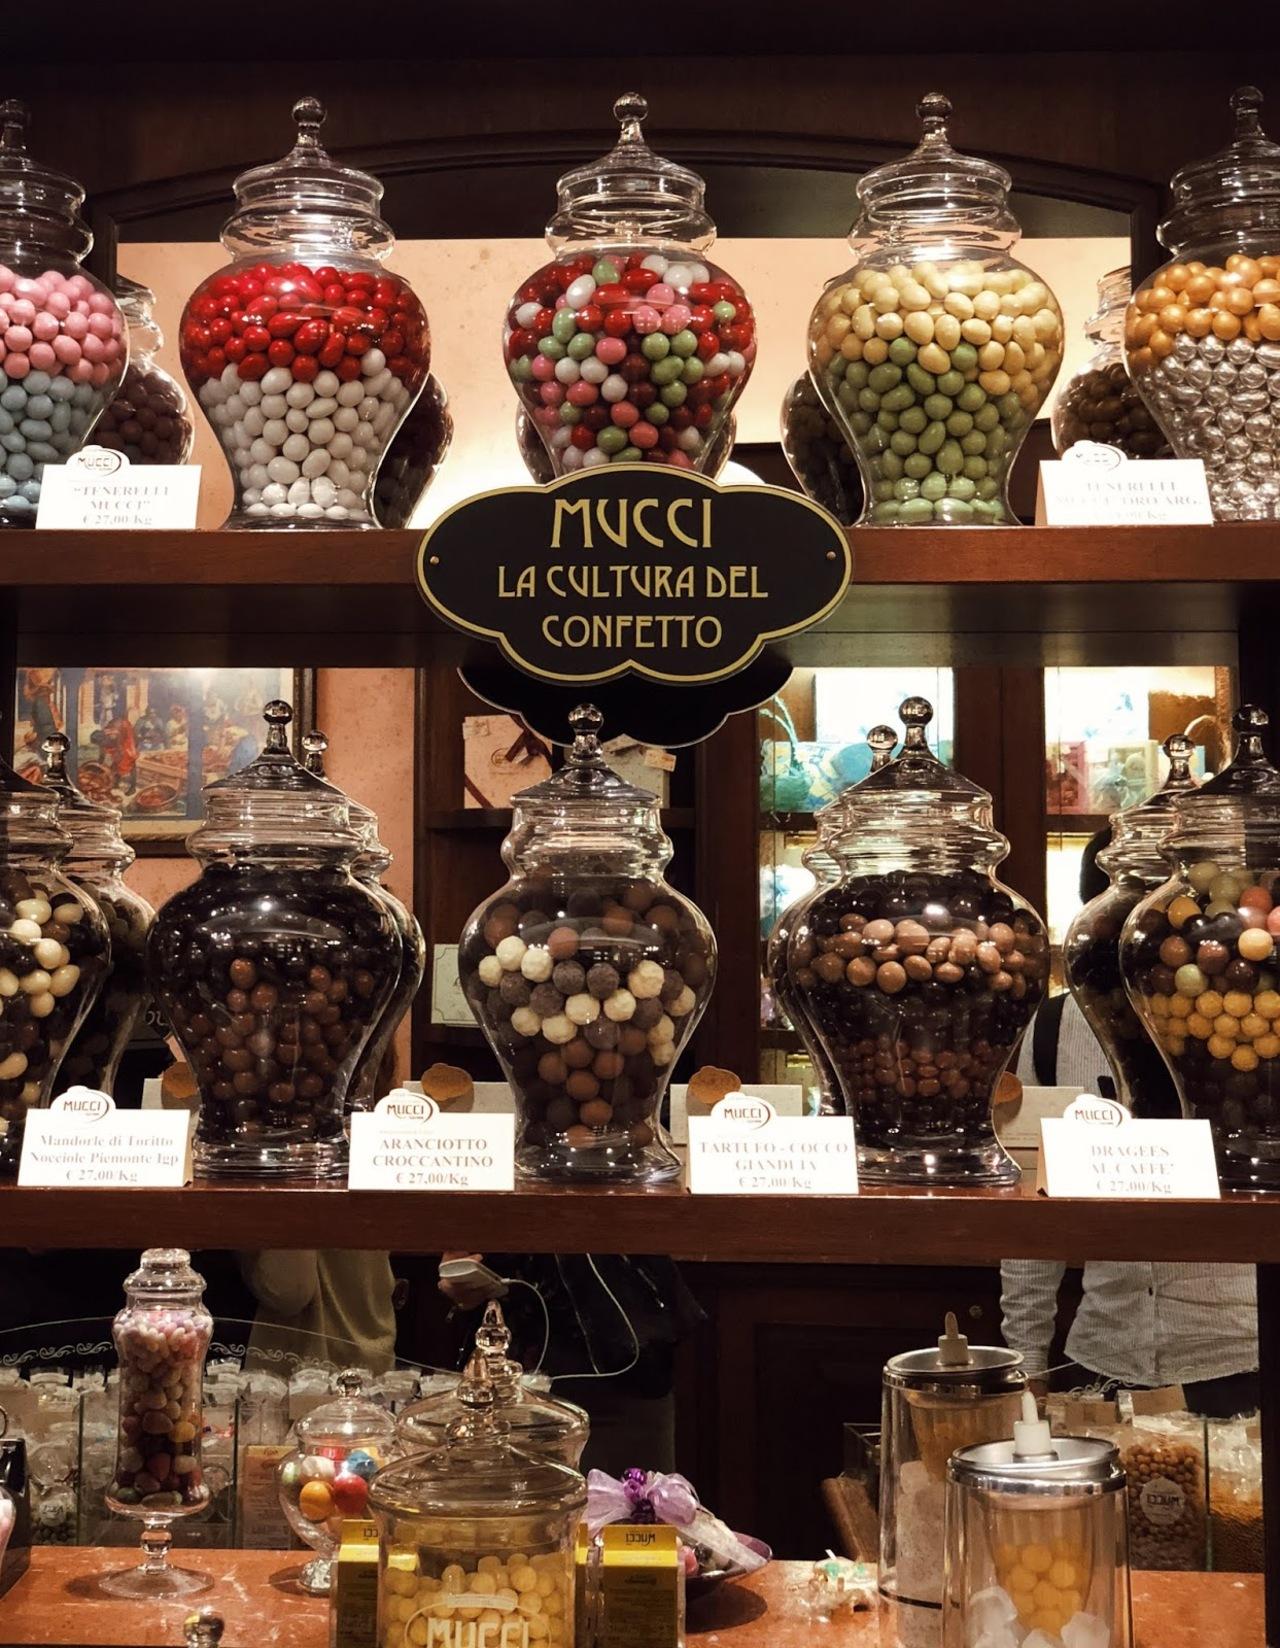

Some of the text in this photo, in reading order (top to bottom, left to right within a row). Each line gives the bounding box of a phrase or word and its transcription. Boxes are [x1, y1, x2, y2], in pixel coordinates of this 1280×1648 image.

[550, 498, 712, 548] MUCCI
[498, 565, 769, 598] LA CULTURA DEL
[541, 615, 723, 648] CONFETTO
[63, 1101, 101, 1111] MUCCI
[387, 1104, 424, 1115] MUCCI
[724, 1108, 762, 1119] MUCCI
[1075, 1110, 1113, 1121] MUCCI
[41, 1135, 103, 1147] Mandorle
[108, 1135, 122, 1147] di
[380, 1139, 488, 1150] ARANCIOTTO
[700, 1142, 776, 1153] TARTUFO
[789, 1142, 848, 1153] COCCO
[1091, 1145, 1170, 1157] DRAGEES
[30, 1152, 179, 1166] Nocciole Piemonte Igp
[373, 1156, 493, 1168] CROCCANTINO
[396, 1172, 469, 1186] € 27,00/Kg
[739, 1177, 747, 1188] €
[427, 1617, 529, 1648] MUCCI
